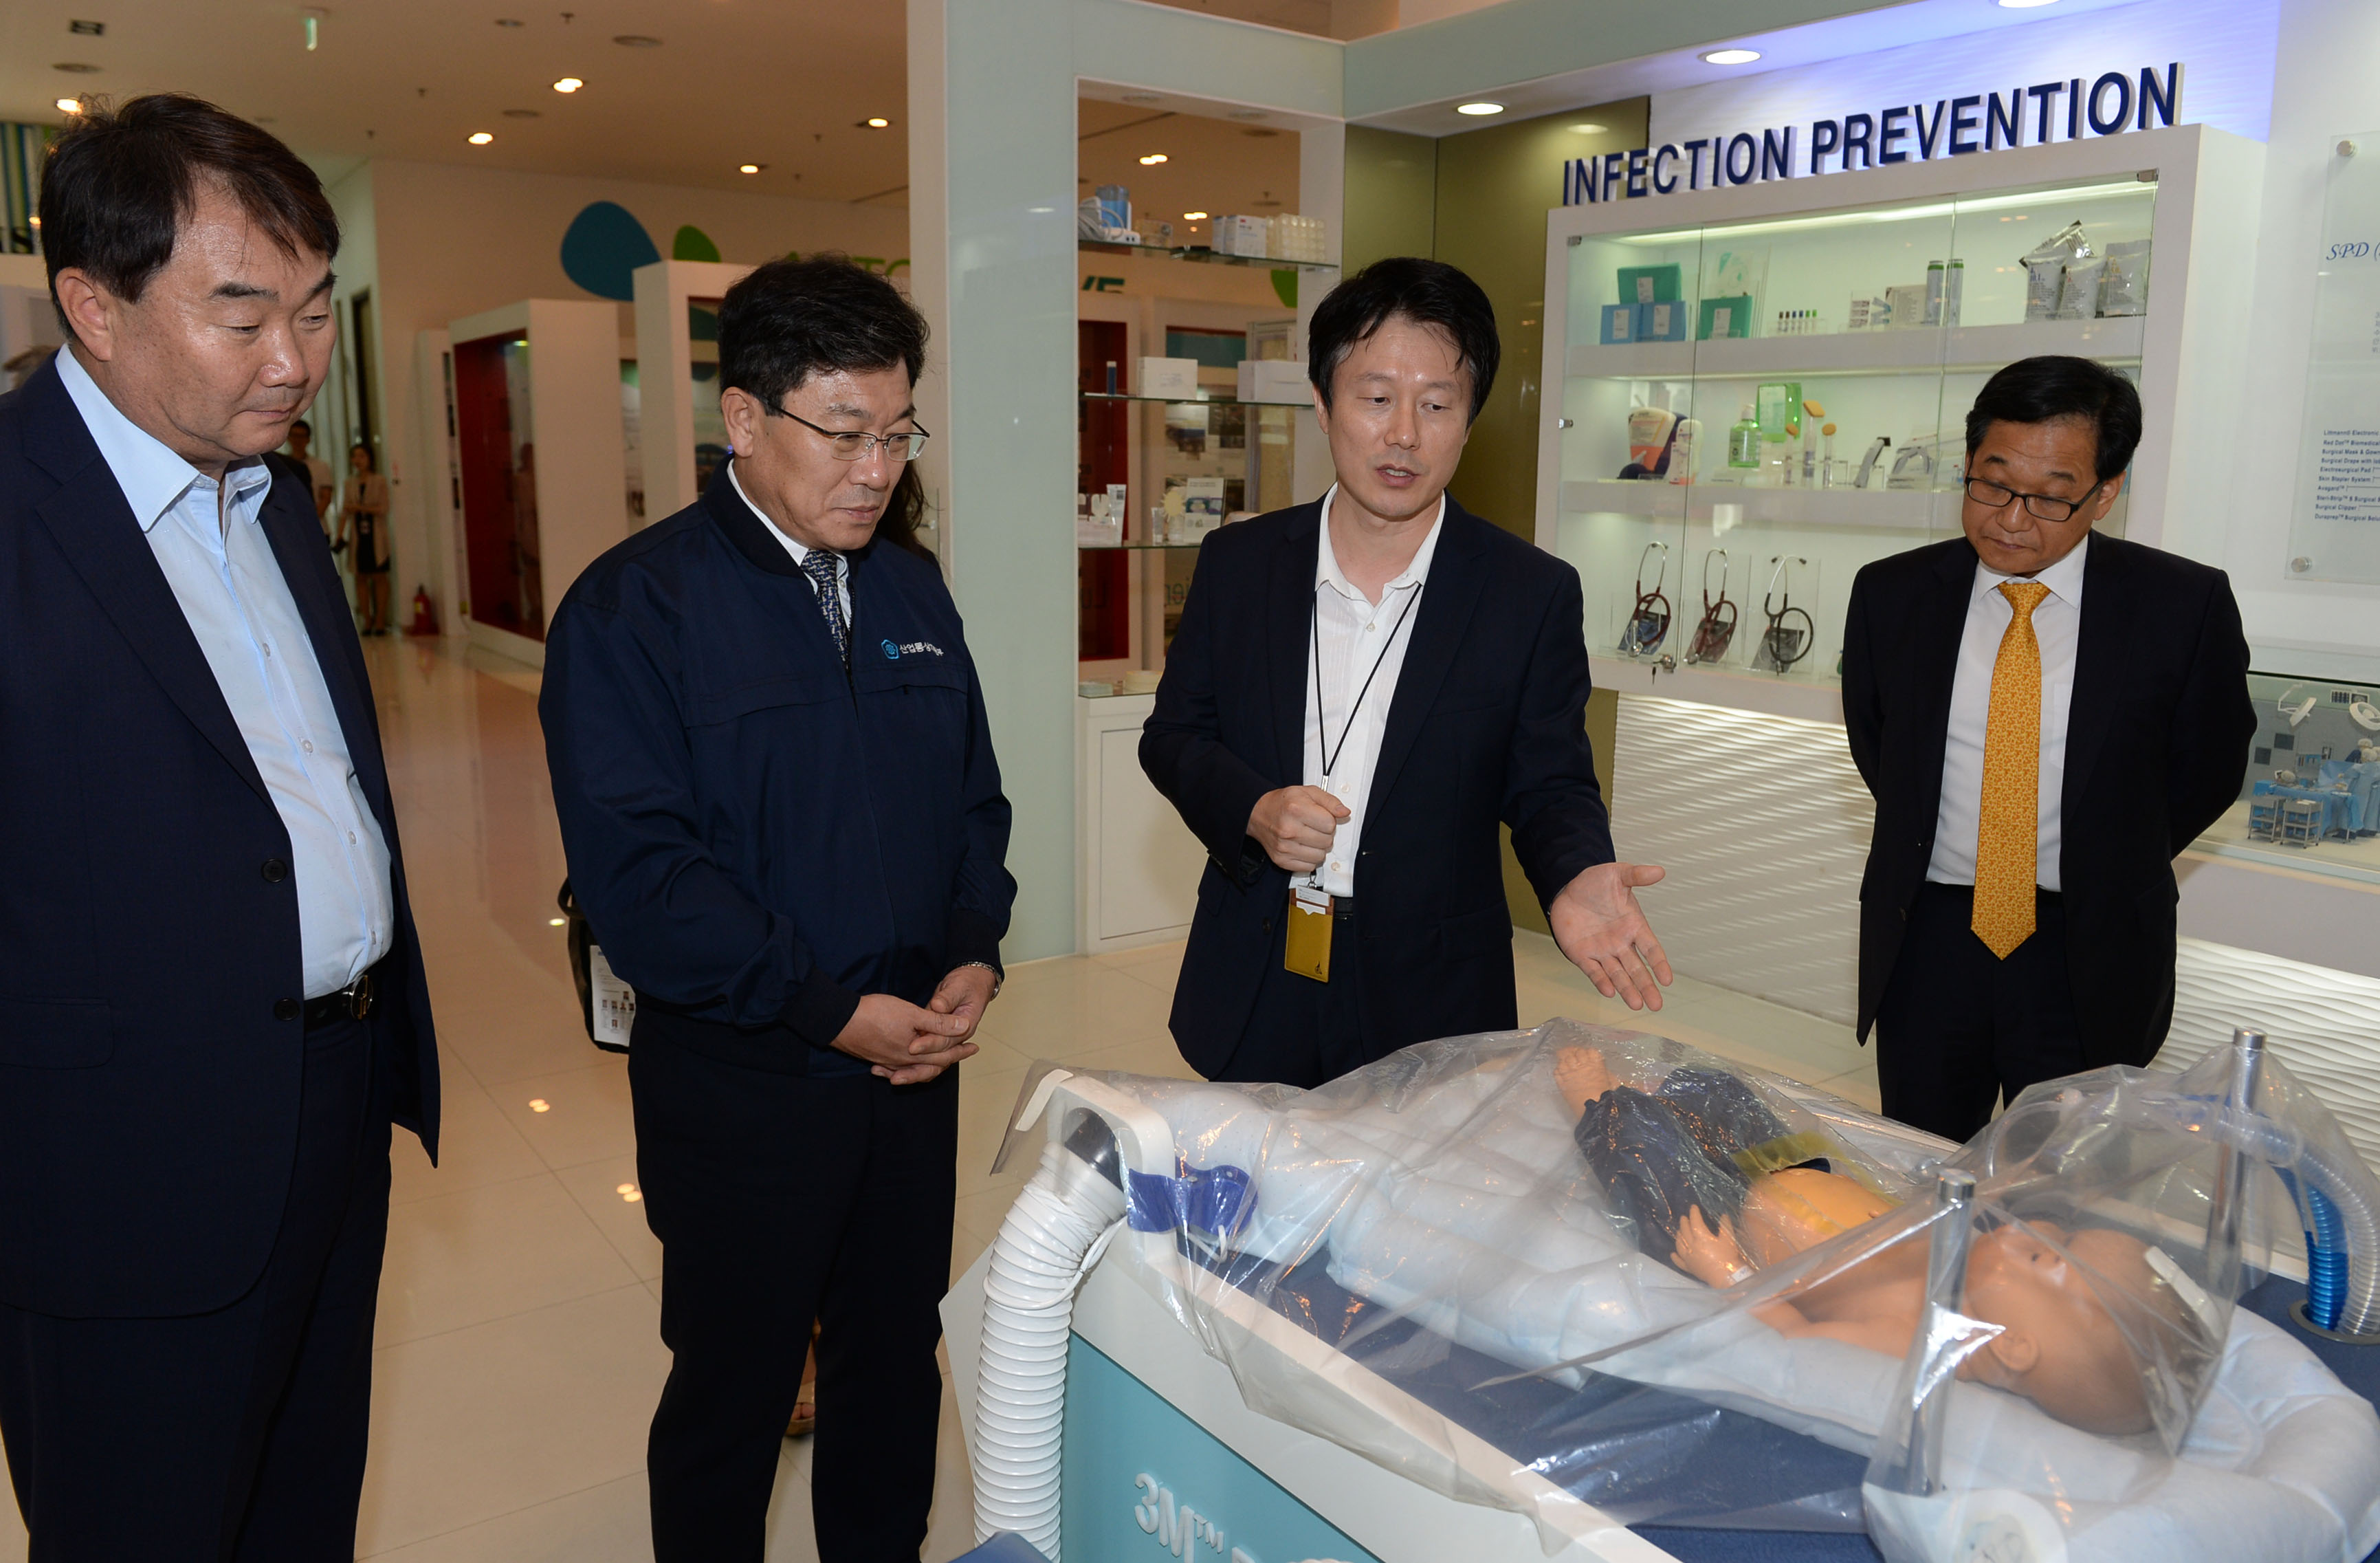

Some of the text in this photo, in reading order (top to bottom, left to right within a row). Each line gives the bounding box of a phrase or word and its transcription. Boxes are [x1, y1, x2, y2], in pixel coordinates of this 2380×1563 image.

[1563, 62, 2183, 206] INFECTION PREVENTION
[2326, 241, 2370, 261] SPD
